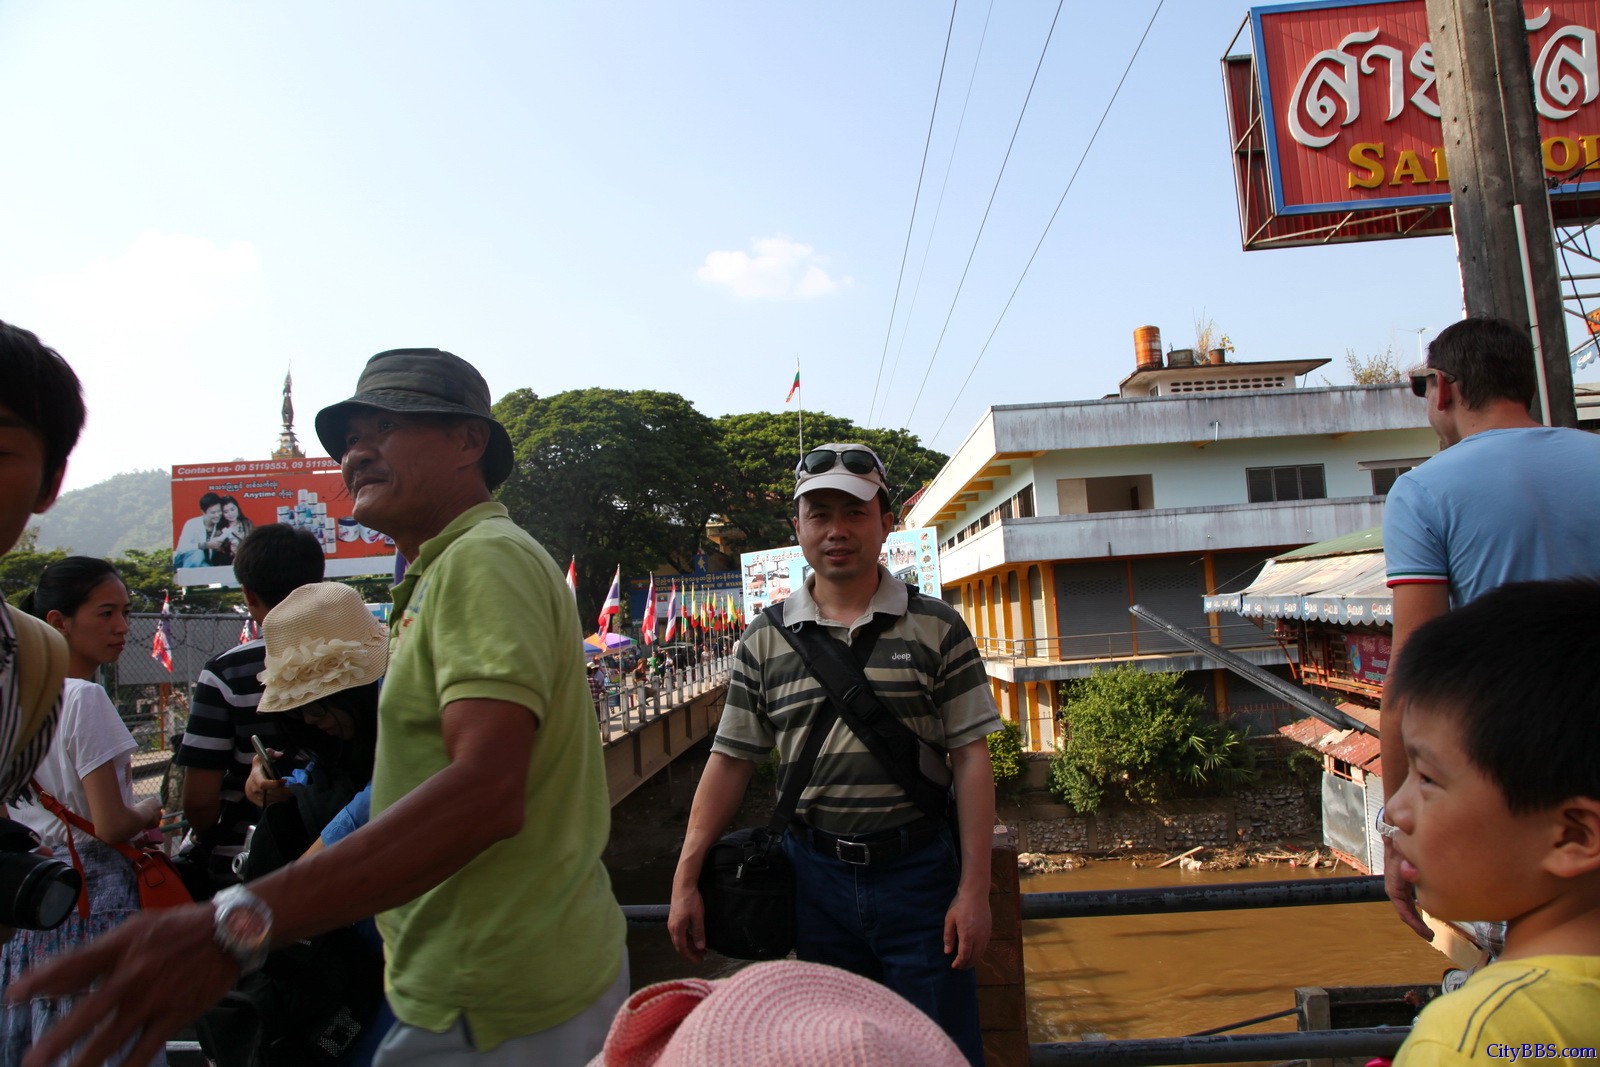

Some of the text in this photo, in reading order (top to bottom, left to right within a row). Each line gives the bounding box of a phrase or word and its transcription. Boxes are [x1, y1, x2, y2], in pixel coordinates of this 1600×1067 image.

[177, 465, 215, 475] Contact
[235, 463, 246, 472] 09
[291, 461, 303, 469] 09
[243, 491, 276, 499] Anytime
[891, 652, 911, 662] Jeep
